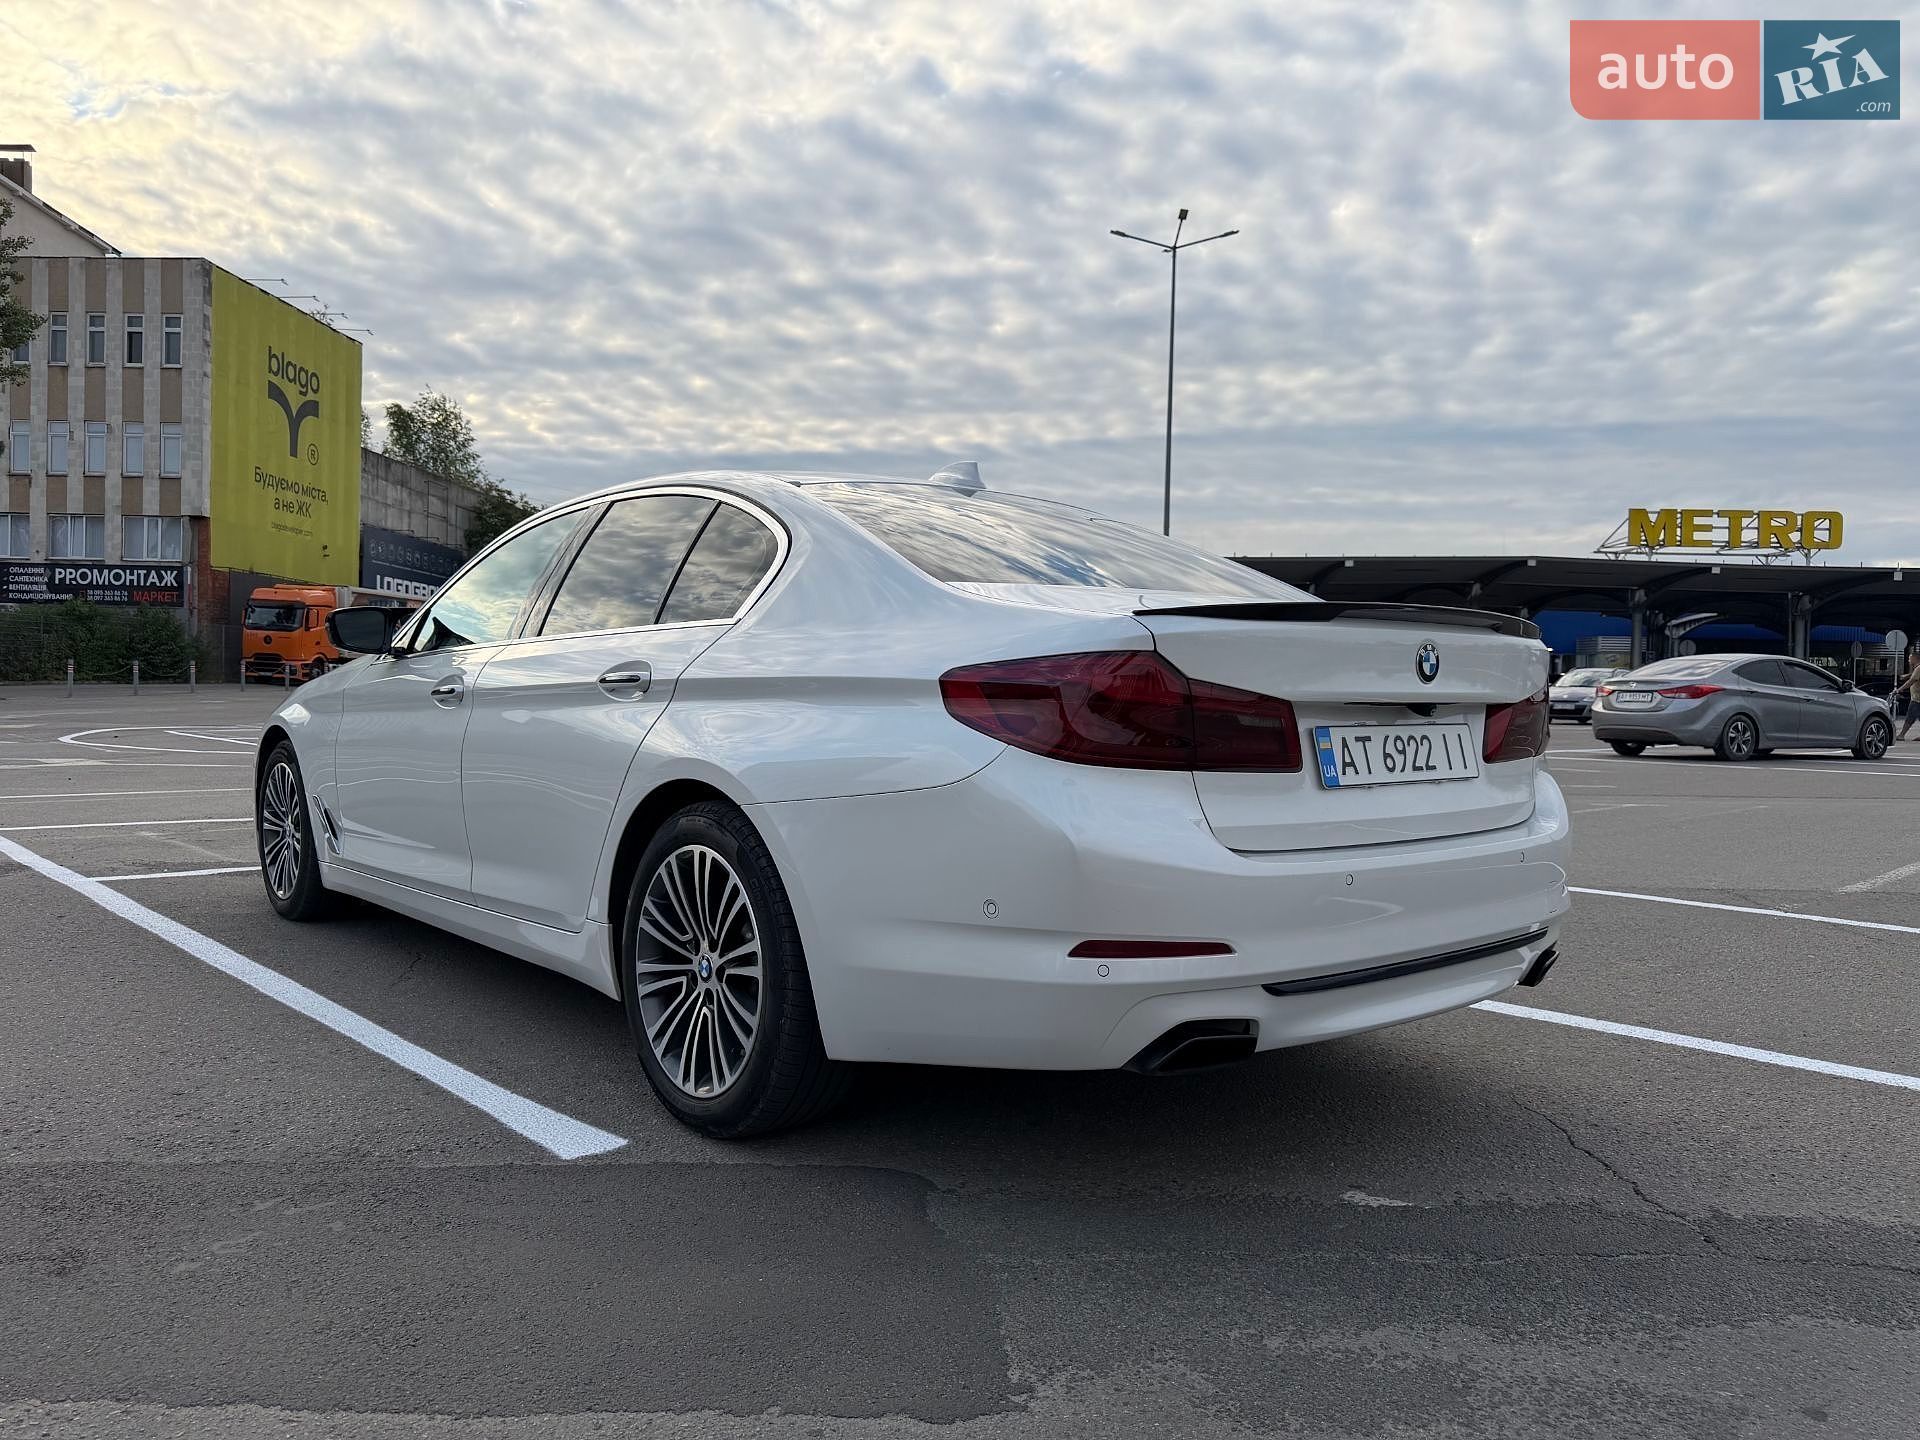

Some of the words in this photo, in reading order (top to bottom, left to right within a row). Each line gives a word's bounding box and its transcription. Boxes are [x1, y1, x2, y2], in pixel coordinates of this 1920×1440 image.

[267, 345, 320, 397] blago
[254, 466, 300, 493] Будуємо
[301, 482, 329, 505] міста,
[274, 497, 280, 511] а
[281, 500, 295, 514] не
[296, 499, 312, 519] ЖК
[1627, 508, 1844, 550] METRO
[9, 566, 45, 574] ОПАЛЕННЯ
[9, 575, 49, 583] САНТЕХНІКА
[132, 591, 179, 602] МАРКЕТ
[1341, 735, 1372, 775] AT
[1382, 734, 1437, 773] 6922
[1324, 765, 1337, 778] UA
